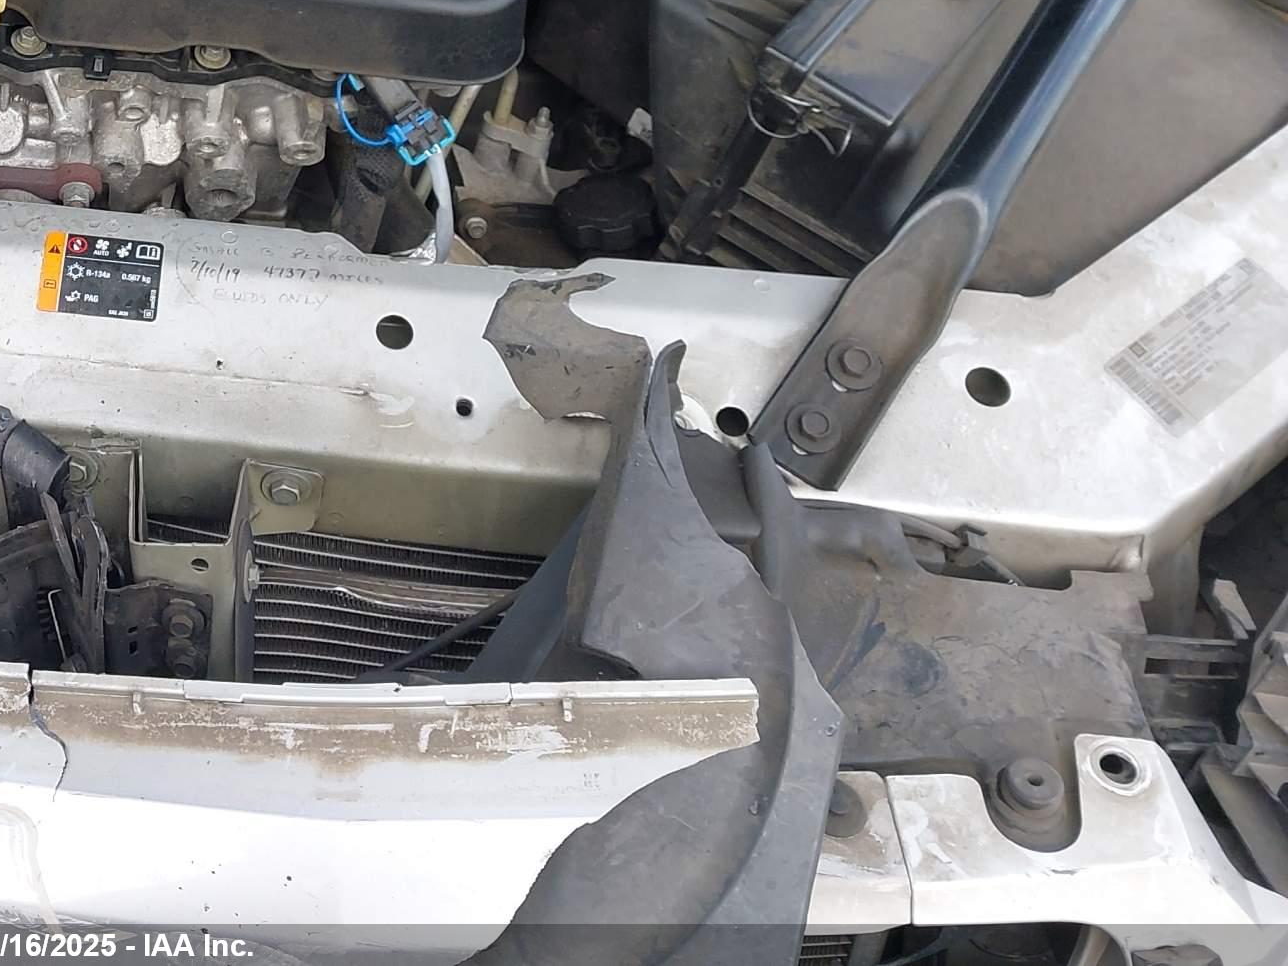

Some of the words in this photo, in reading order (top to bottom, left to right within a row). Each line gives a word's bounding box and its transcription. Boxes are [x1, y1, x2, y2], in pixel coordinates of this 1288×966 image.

[93, 249, 110, 257] AUTO
[85, 269, 111, 279] R-134a
[141, 274, 152, 285] kg
[83, 294, 100, 303] PAG
